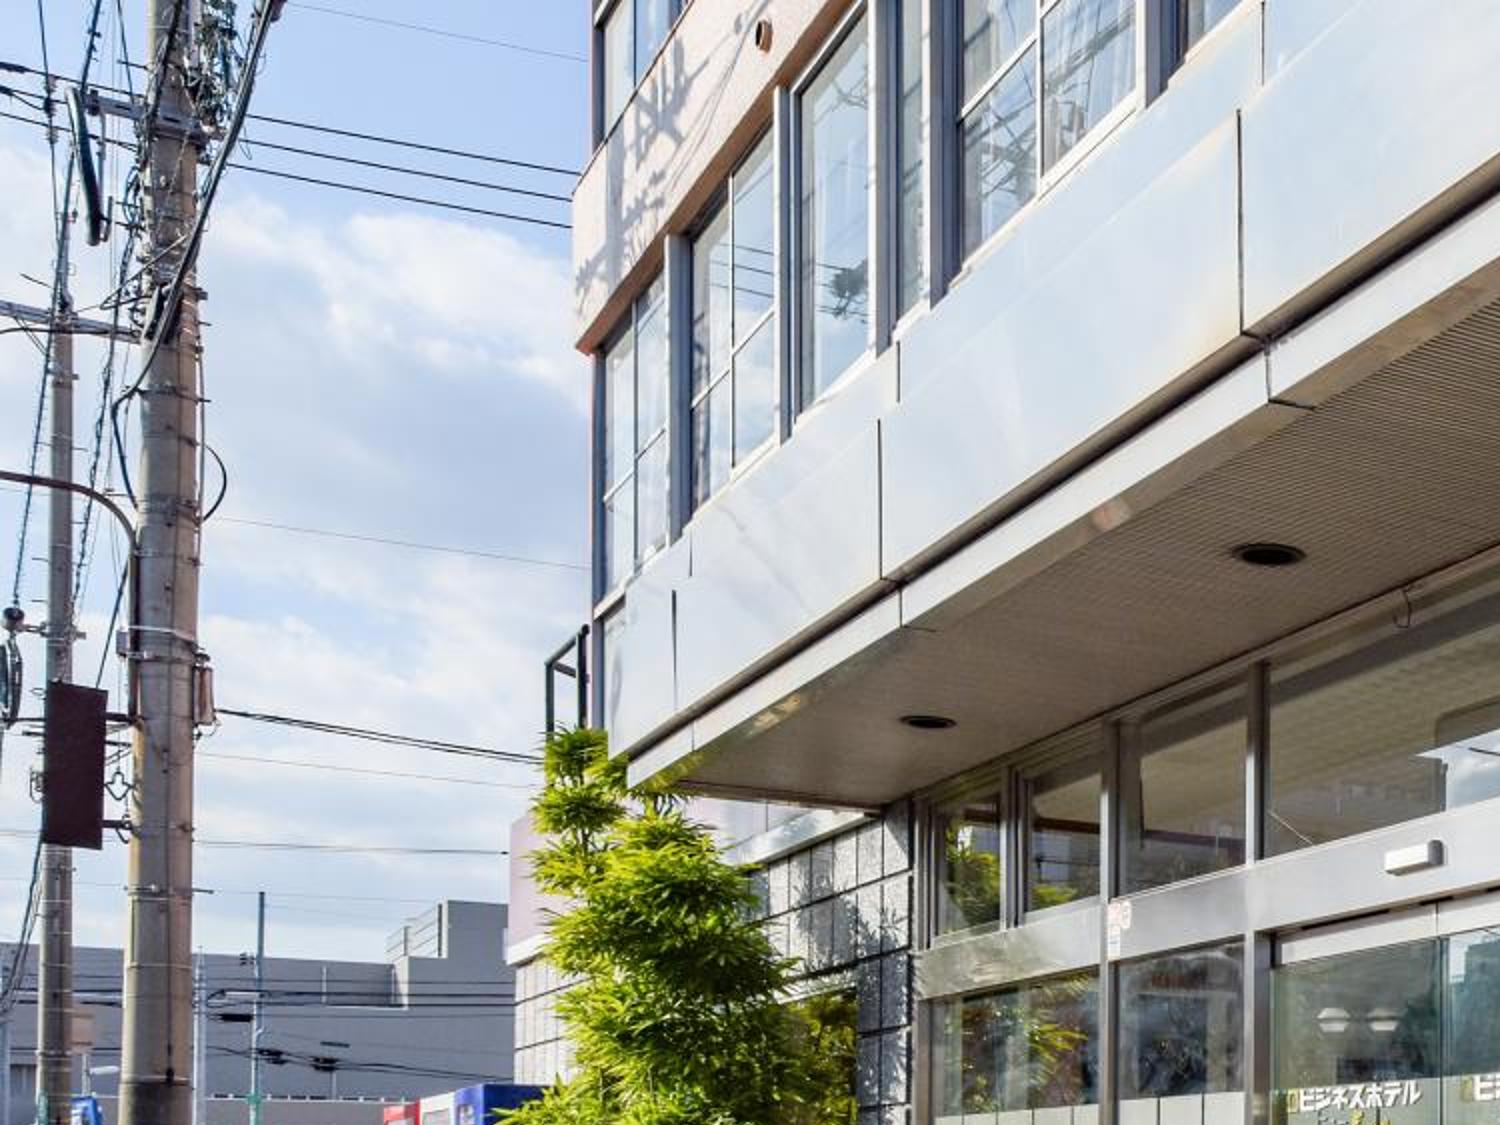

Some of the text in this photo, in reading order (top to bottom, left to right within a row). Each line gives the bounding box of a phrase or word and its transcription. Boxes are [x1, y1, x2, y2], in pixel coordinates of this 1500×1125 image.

[1299, 1080, 1422, 1112] ビジネスホテル
